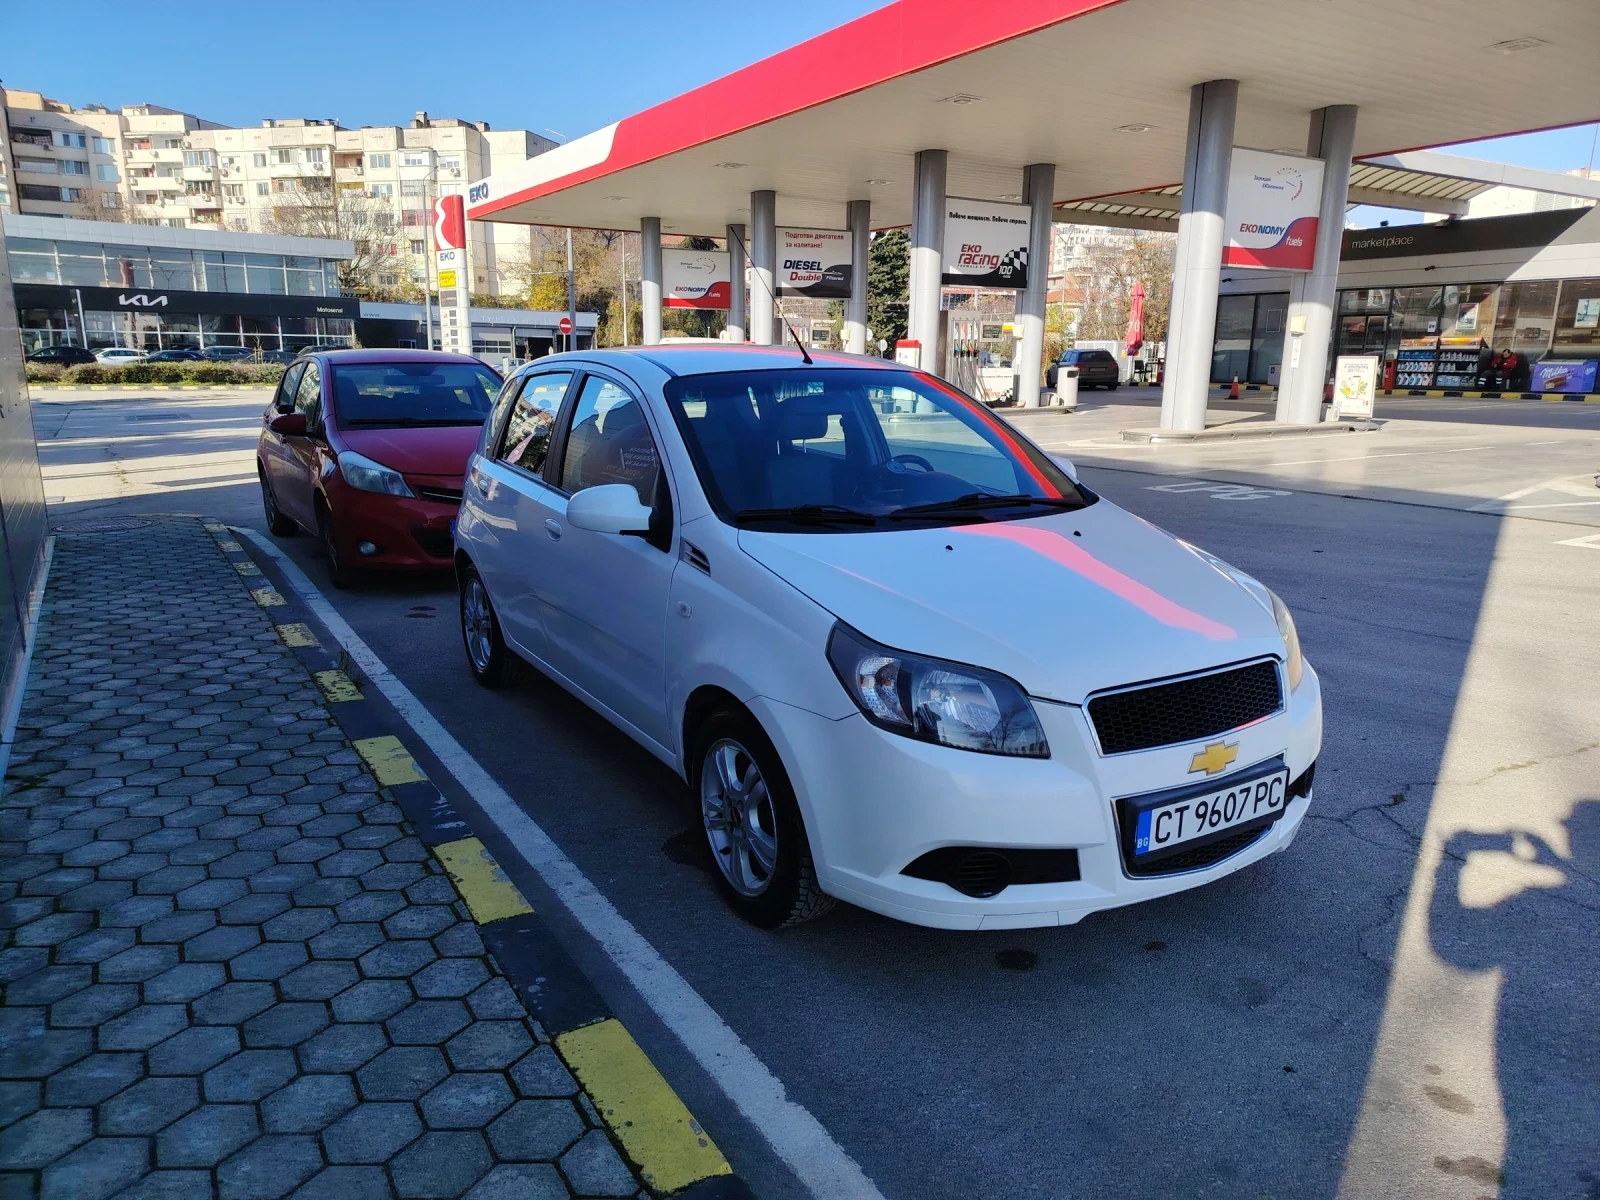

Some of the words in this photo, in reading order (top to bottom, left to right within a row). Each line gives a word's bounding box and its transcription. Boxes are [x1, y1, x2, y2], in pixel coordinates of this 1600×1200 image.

[469, 182, 489, 202] EKO
[949, 212, 966, 220] Повече
[1240, 223, 1286, 236] EKONOMY
[785, 231, 813, 240] Подготви
[1286, 236, 1303, 247] fuels
[1351, 235, 1414, 249] marketplace
[961, 244, 982, 253] EKO
[439, 252, 455, 262] EKO
[958, 253, 1000, 270] racing
[783, 260, 823, 271] DIESEL
[998, 265, 1013, 275] 100
[790, 272, 822, 281] Double
[118, 294, 168, 307] KIA
[316, 306, 344, 314] Motosensi
[1539, 366, 1568, 379] Milka
[1155, 804, 1190, 844] CT
[1195, 786, 1252, 833] 9607
[1253, 776, 1283, 815] PC
[1137, 837, 1149, 849] BG
